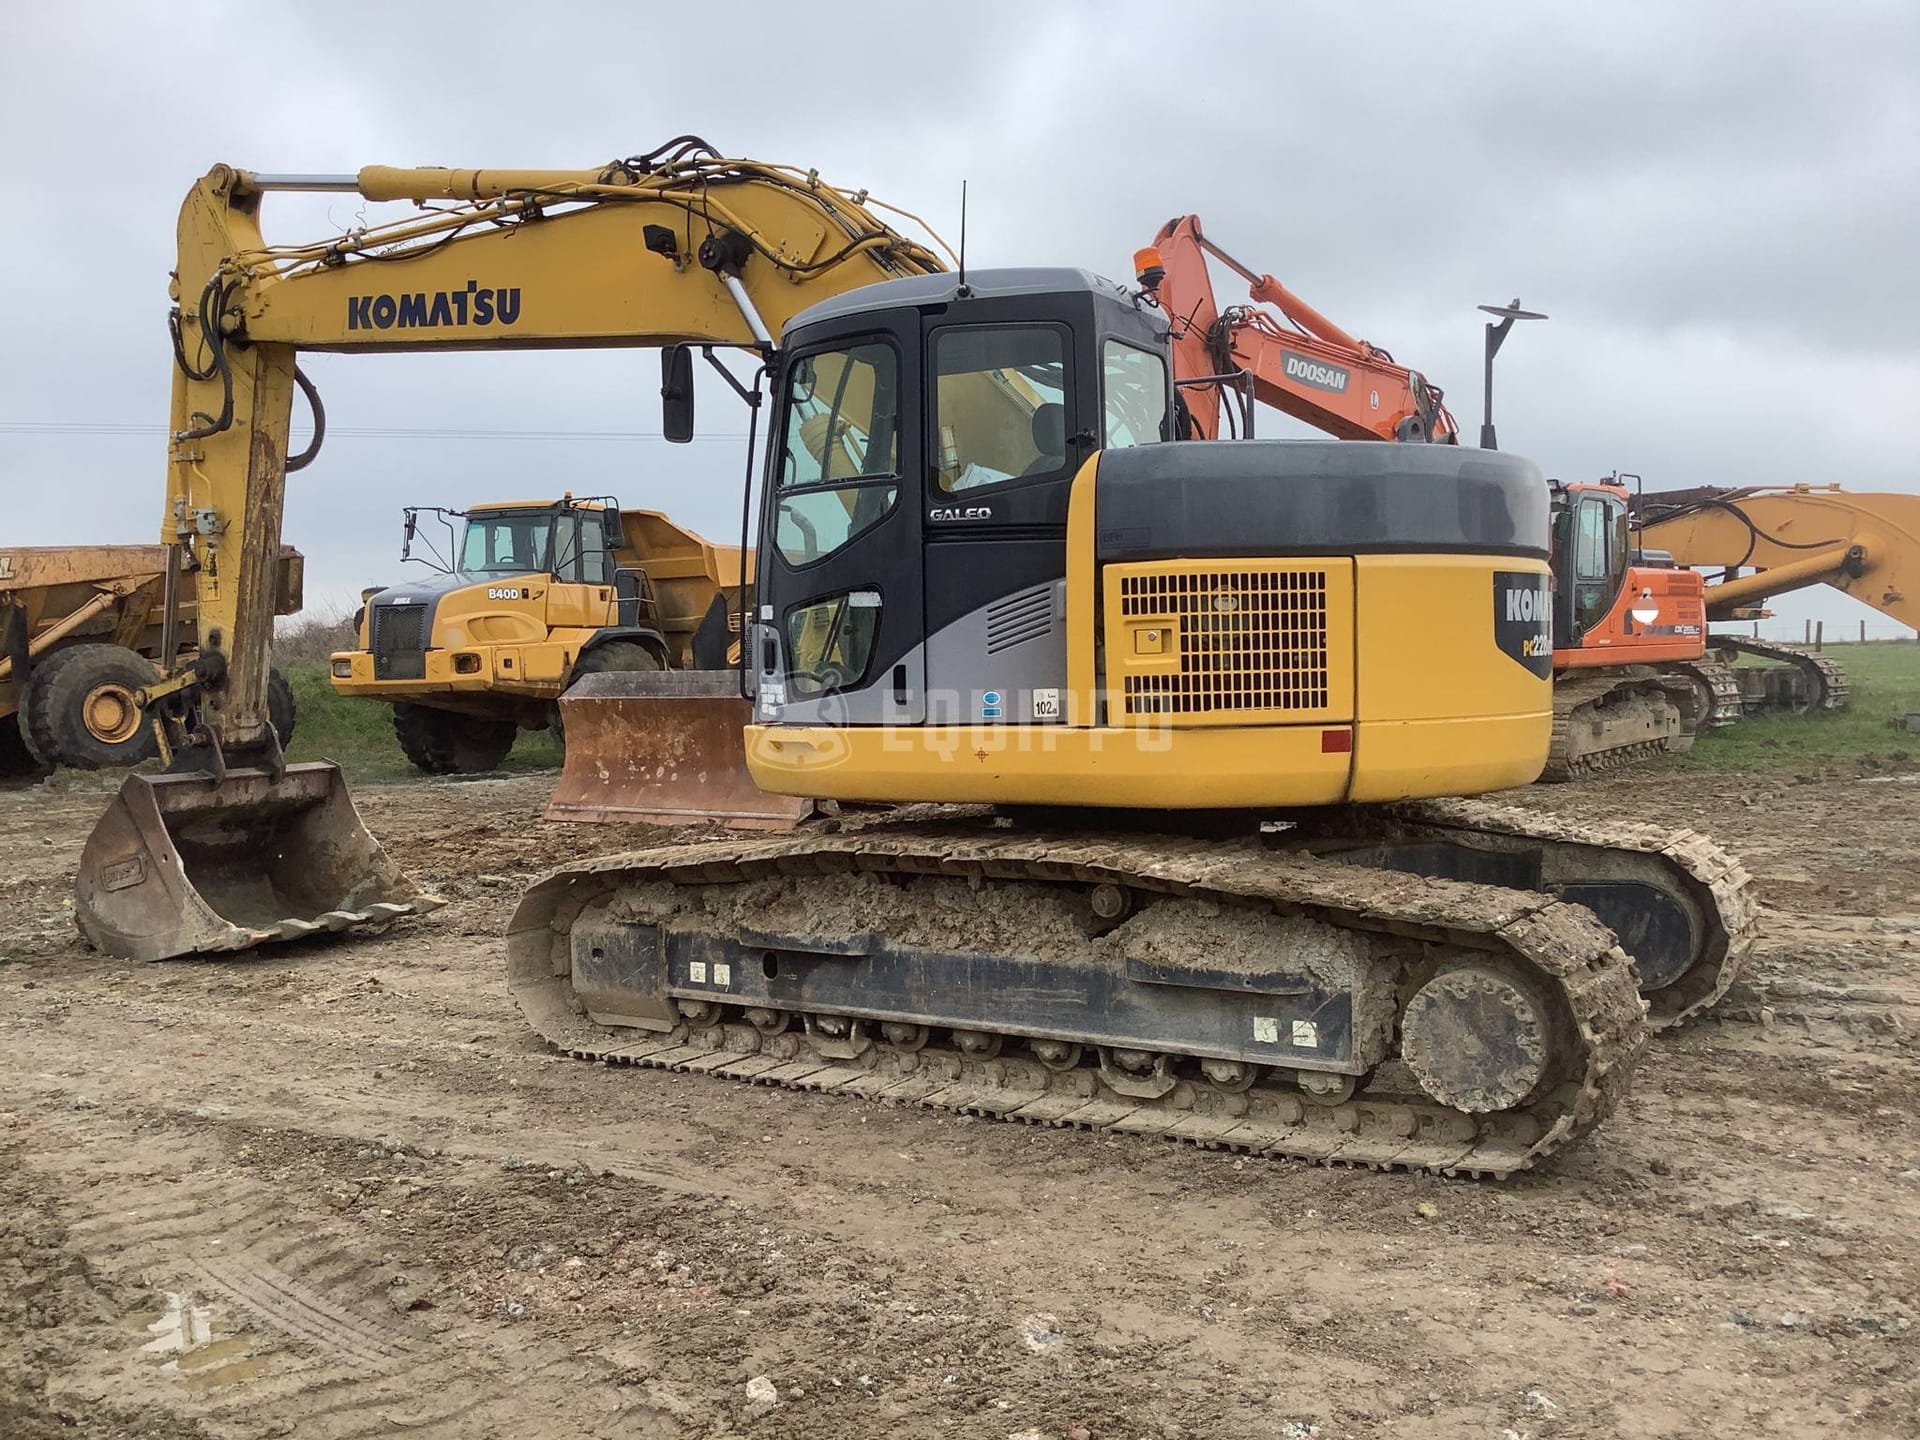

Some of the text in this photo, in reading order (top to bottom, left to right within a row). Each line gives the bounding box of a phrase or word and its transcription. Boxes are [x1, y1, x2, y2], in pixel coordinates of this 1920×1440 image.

[348, 280, 521, 330] KOMATSU
[1286, 357, 1347, 390] DOOSAN
[929, 507, 992, 521] GALEO
[488, 588, 519, 600] B40D
[1036, 701, 1052, 715] 102
